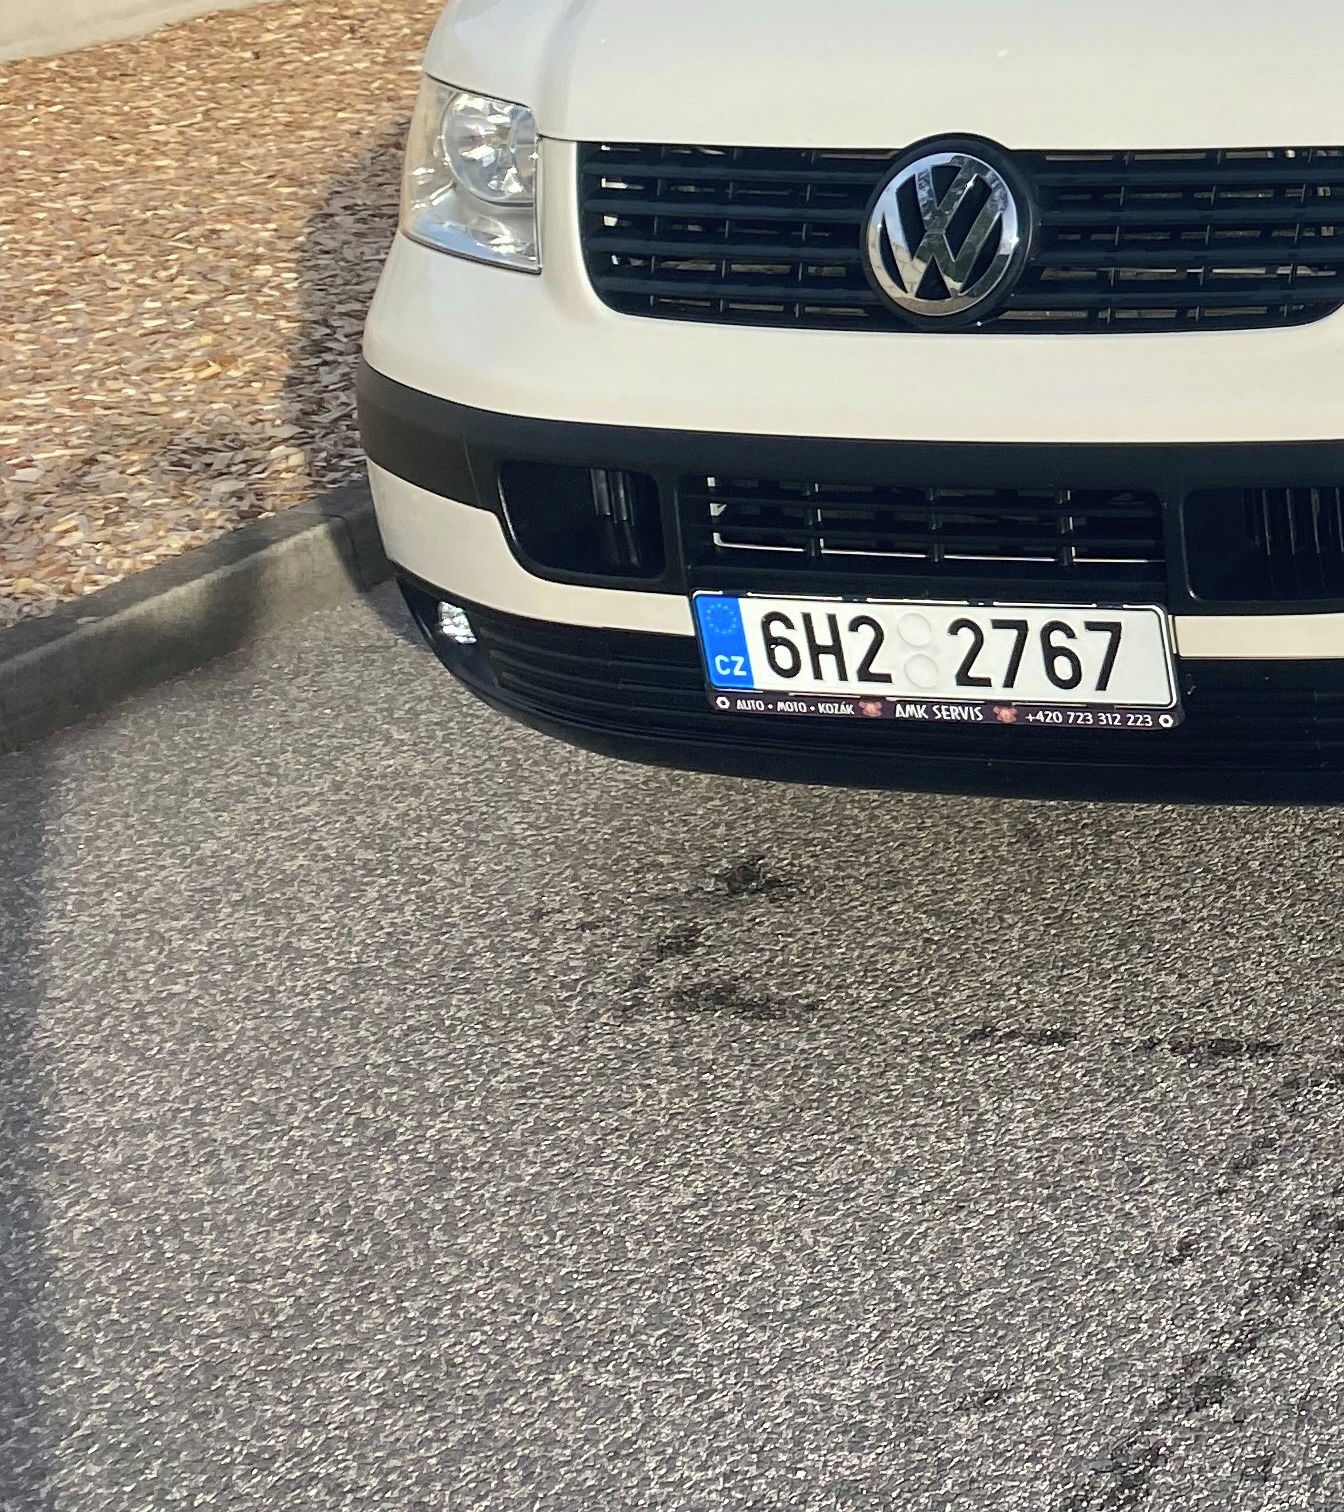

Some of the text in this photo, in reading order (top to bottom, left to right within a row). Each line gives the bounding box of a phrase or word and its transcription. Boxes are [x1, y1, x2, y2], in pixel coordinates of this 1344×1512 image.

[760, 611, 1122, 691] 6H2 2767
[714, 655, 747, 677] CZ
[736, 699, 854, 715] AUTO MOTO KOZÁK
[895, 704, 983, 721] AMK SERVIS
[1025, 712, 1153, 727] +420 723 312 223
